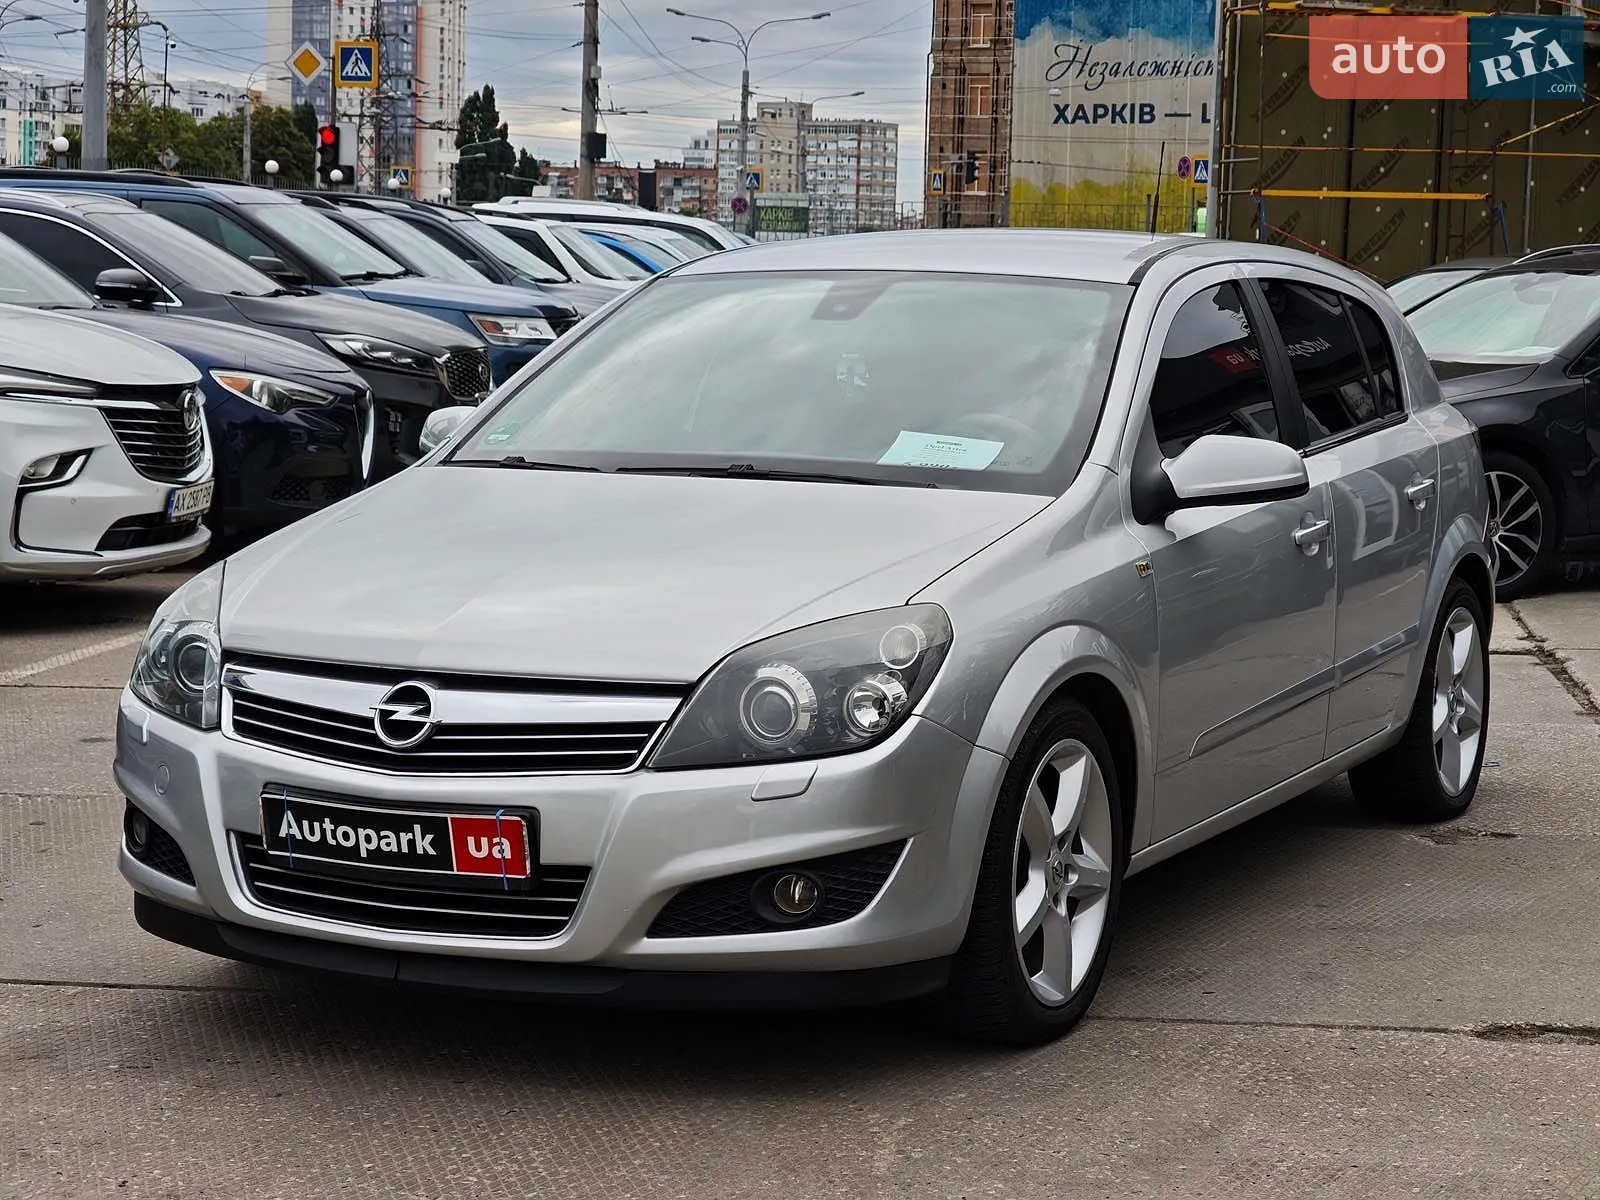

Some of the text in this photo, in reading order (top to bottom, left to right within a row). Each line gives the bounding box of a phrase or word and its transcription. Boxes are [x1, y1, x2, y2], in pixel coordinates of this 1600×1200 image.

[1053, 103, 1156, 125] ХАРКІВ
[760, 207, 793, 220] ХАРКІВ
[174, 491, 188, 512] AX
[278, 810, 512, 860] Autopark ua
